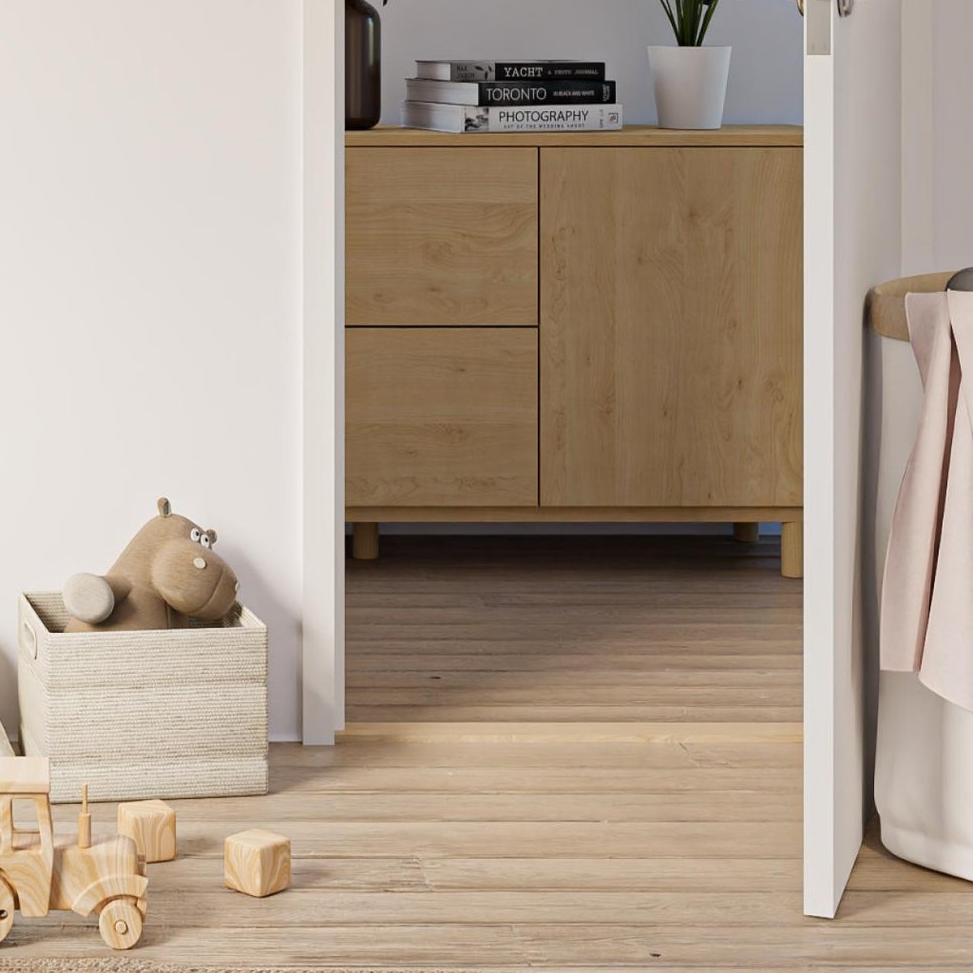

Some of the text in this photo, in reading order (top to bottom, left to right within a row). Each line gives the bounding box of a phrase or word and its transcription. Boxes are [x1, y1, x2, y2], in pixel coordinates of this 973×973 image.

[504, 67, 544, 77] YACHT
[486, 87, 547, 101] TORONTO
[499, 110, 589, 122] PHOTOGRAPHY
